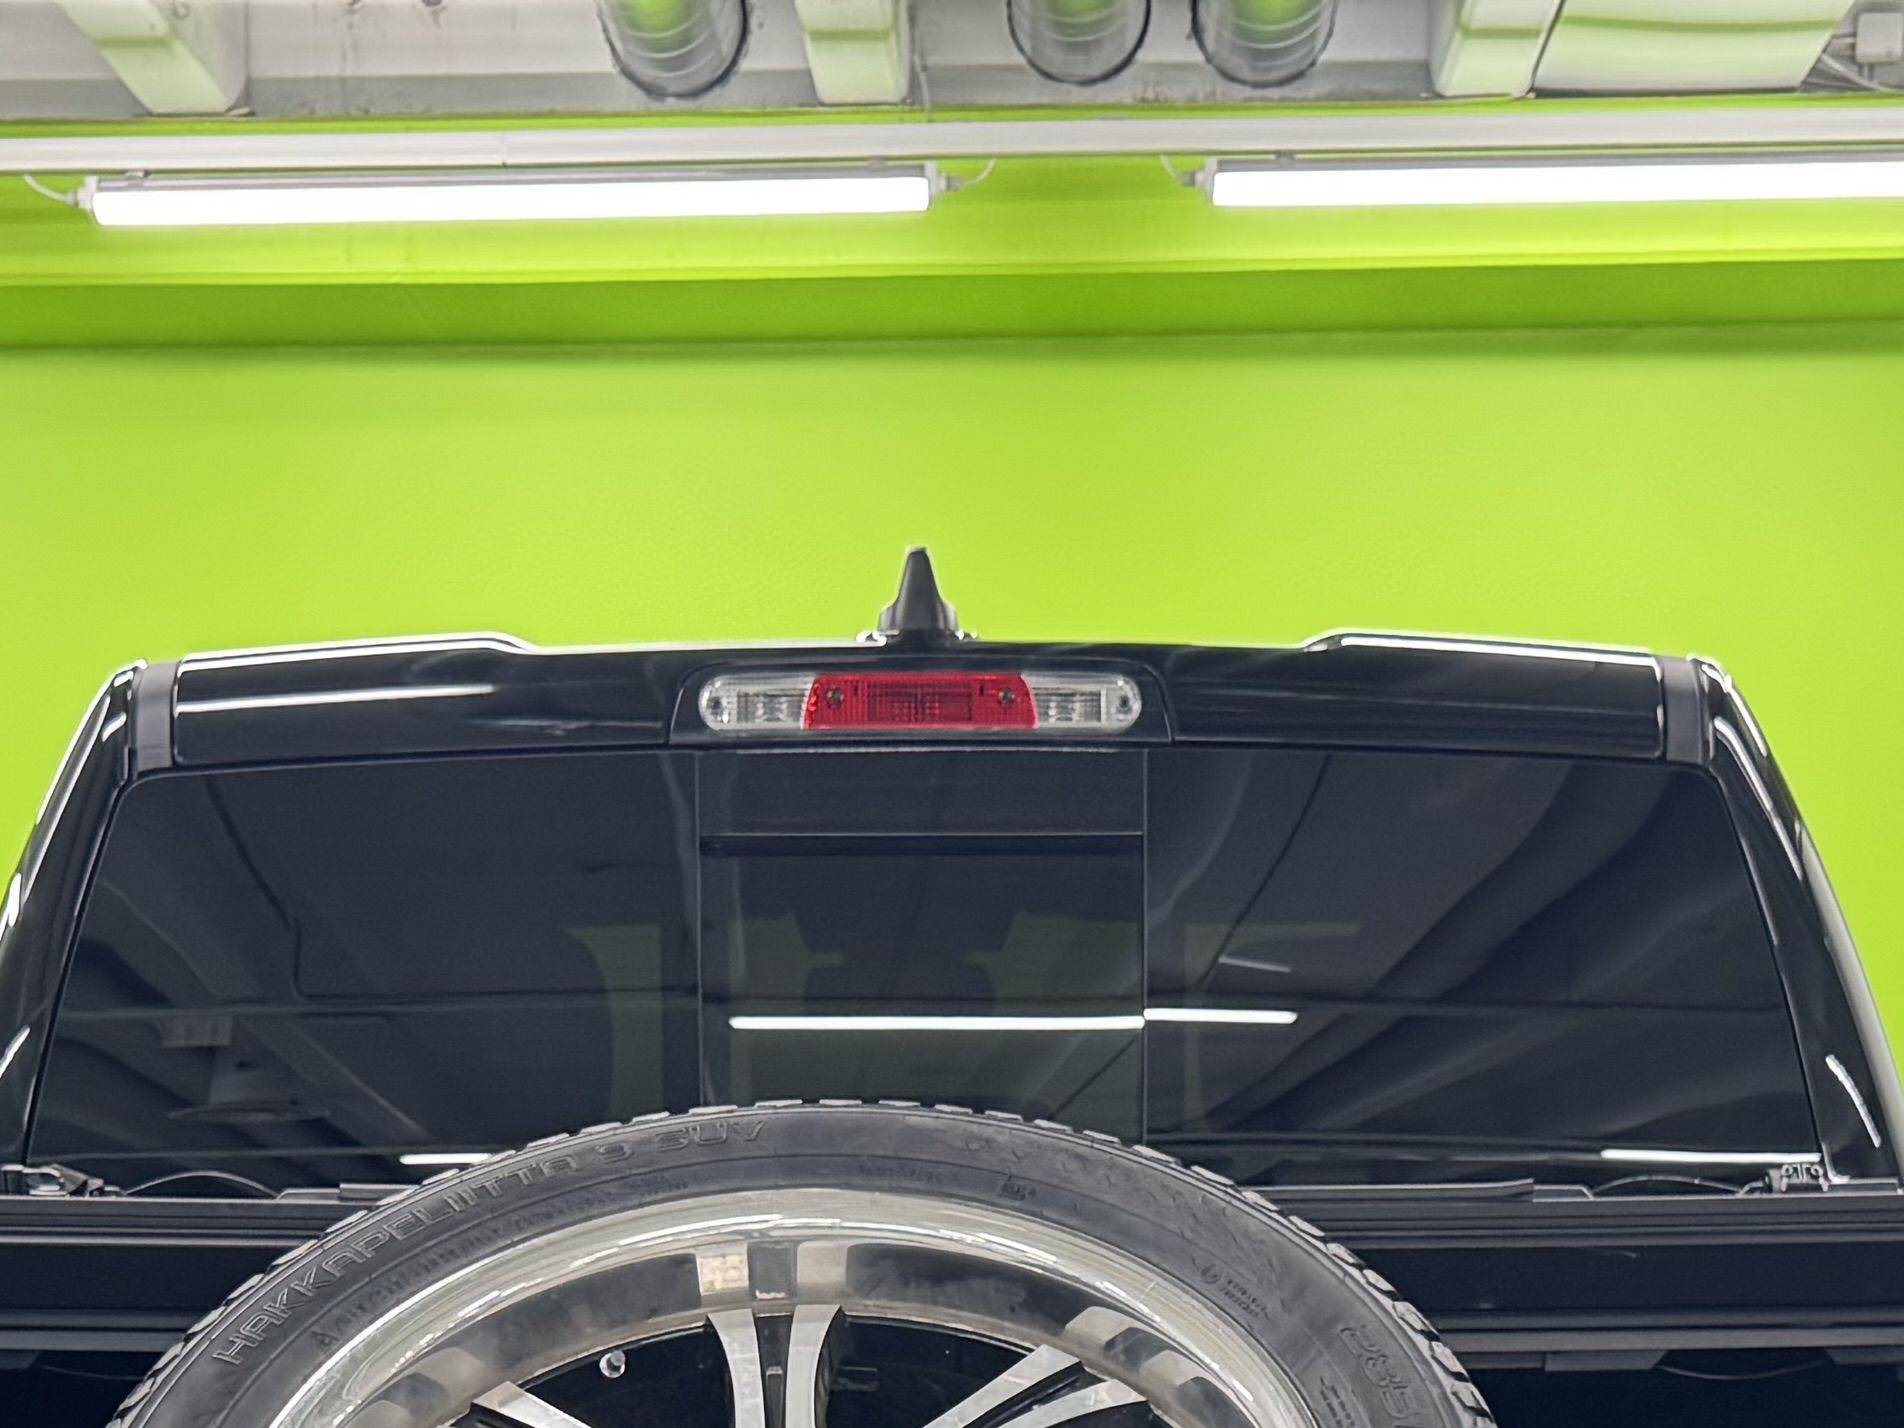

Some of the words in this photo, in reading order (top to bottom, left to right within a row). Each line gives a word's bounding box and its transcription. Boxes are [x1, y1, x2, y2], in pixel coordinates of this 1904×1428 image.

[212, 1155, 580, 1366] HAKKAPELIITTA
[598, 1140, 634, 1166] 9
[654, 1119, 768, 1152] SUV
